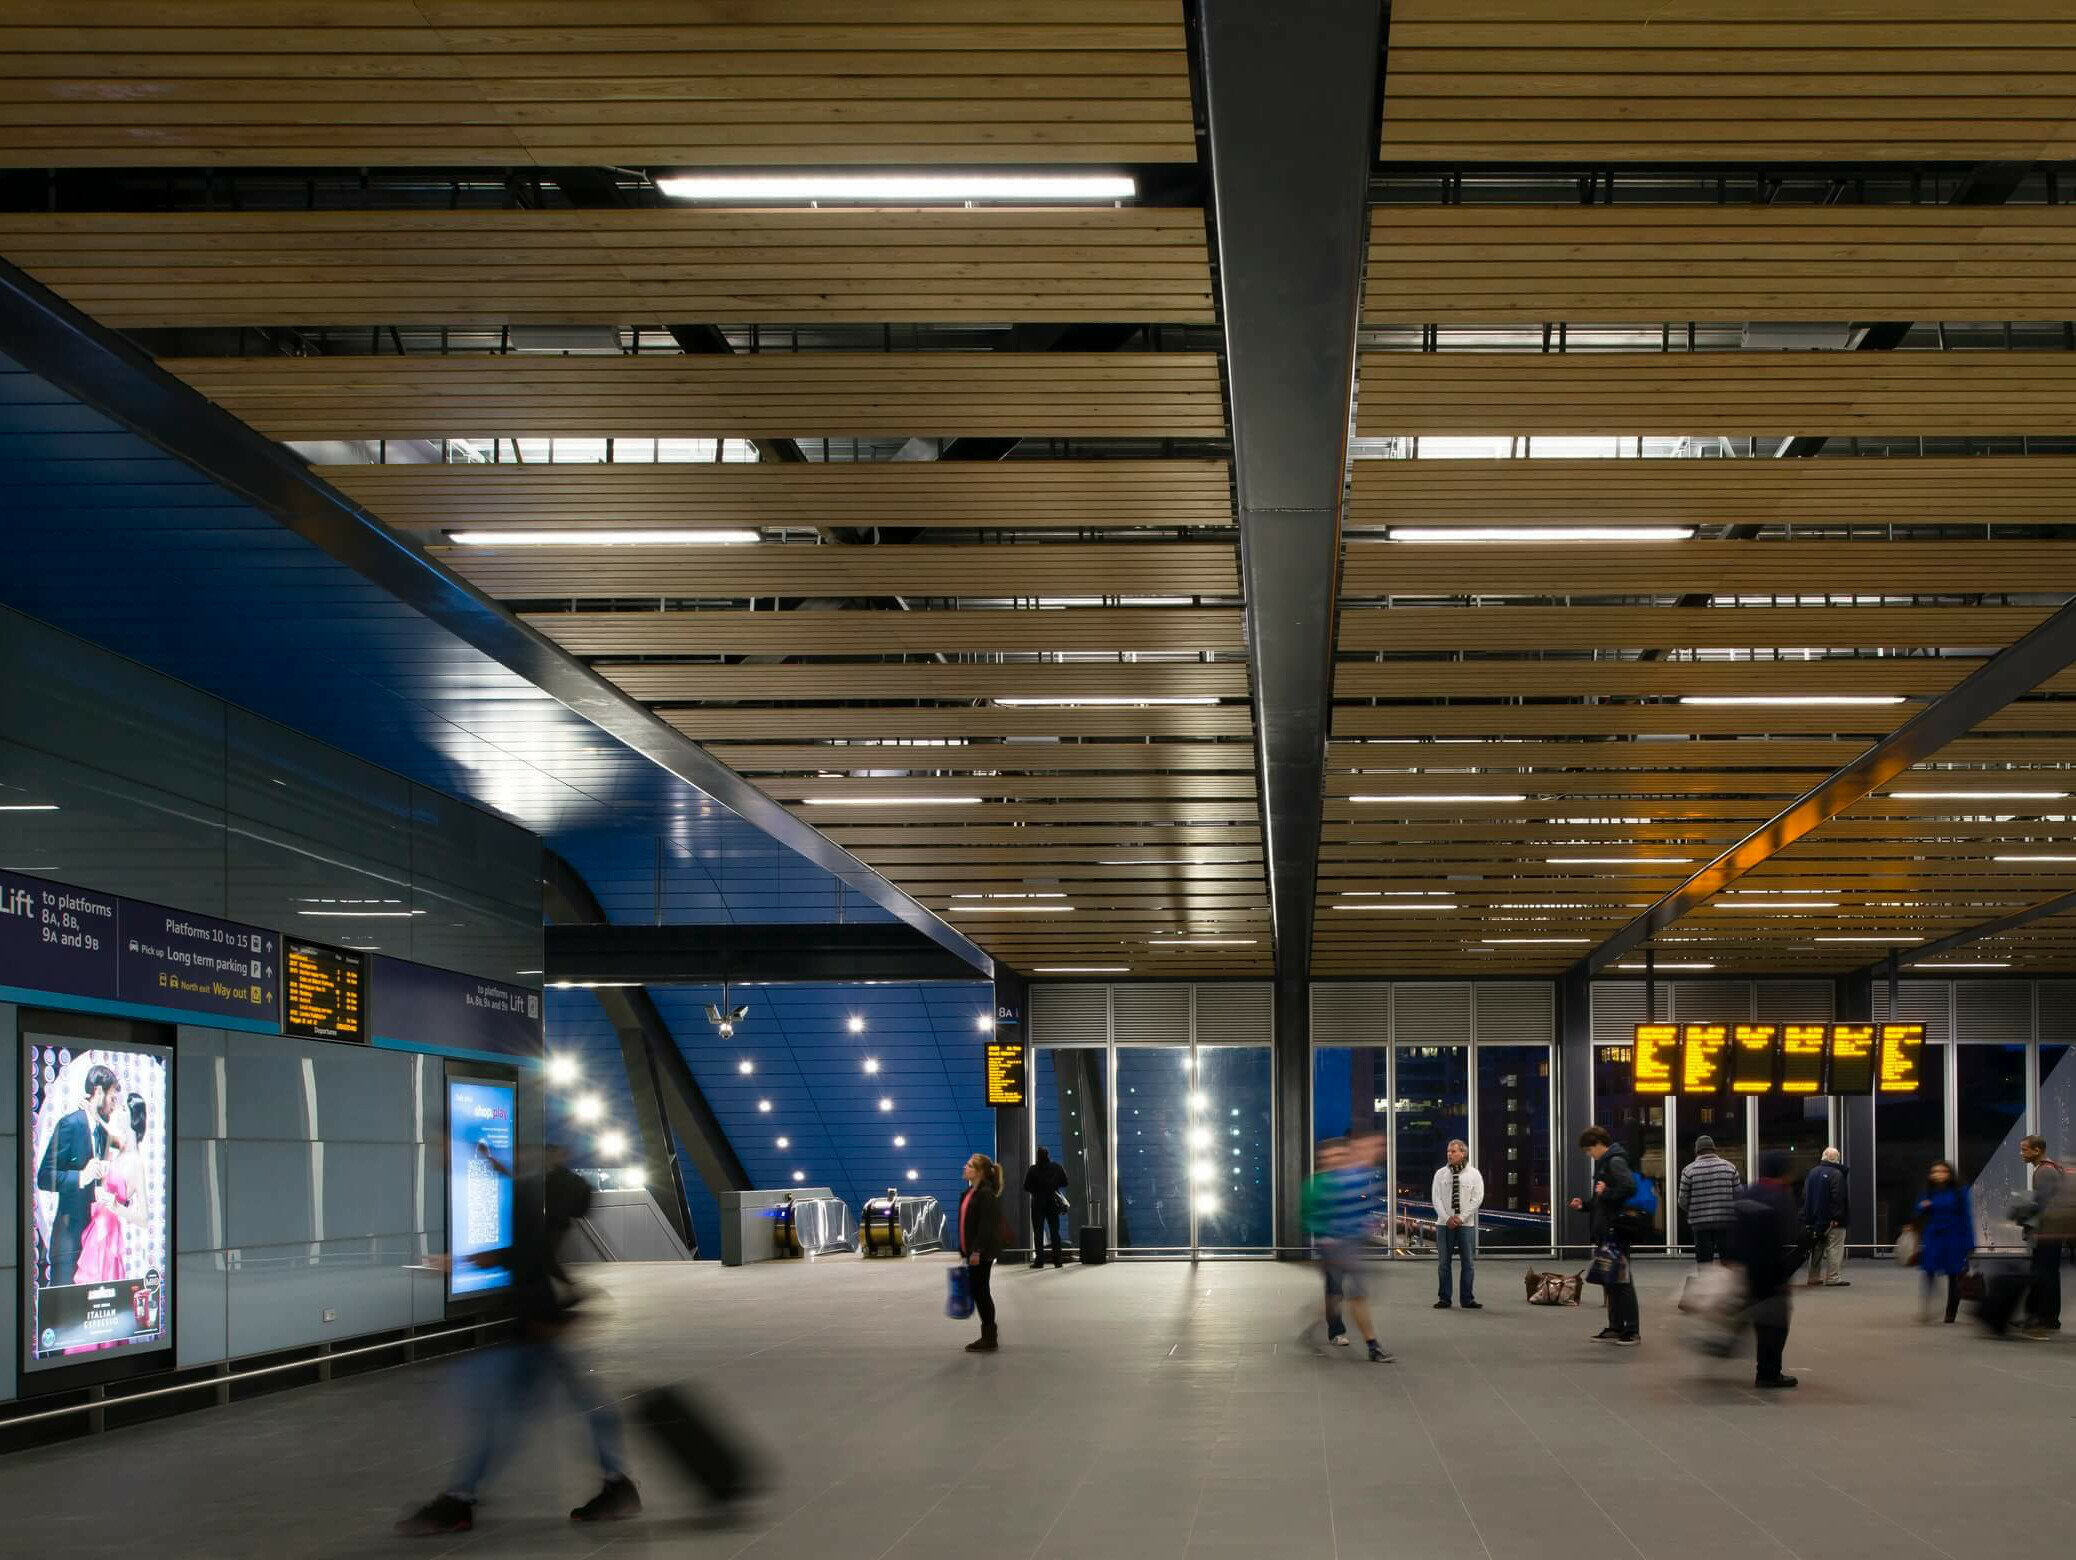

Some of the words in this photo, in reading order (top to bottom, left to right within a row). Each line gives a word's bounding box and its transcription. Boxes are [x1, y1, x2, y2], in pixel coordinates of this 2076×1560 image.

[0, 885, 34, 918] Lift
[42, 890, 55, 905] to
[58, 893, 111, 917] platforms
[42, 908, 60, 927] 8A,
[62, 912, 79, 931] 8B,
[42, 927, 58, 943] 9A
[61, 933, 82, 947] and
[85, 935, 99, 950] 9B
[166, 918, 210, 941] Platforms
[212, 929, 224, 943] 10
[226, 932, 235, 945] to
[237, 934, 248, 948] 15
[167, 946, 191, 967] Long
[193, 952, 215, 968] term
[216, 958, 248, 977] parking
[213, 982, 231, 999] Way
[232, 987, 247, 999] out
[510, 994, 525, 1014] Lift
[999, 1007, 1013, 1018] 8A
